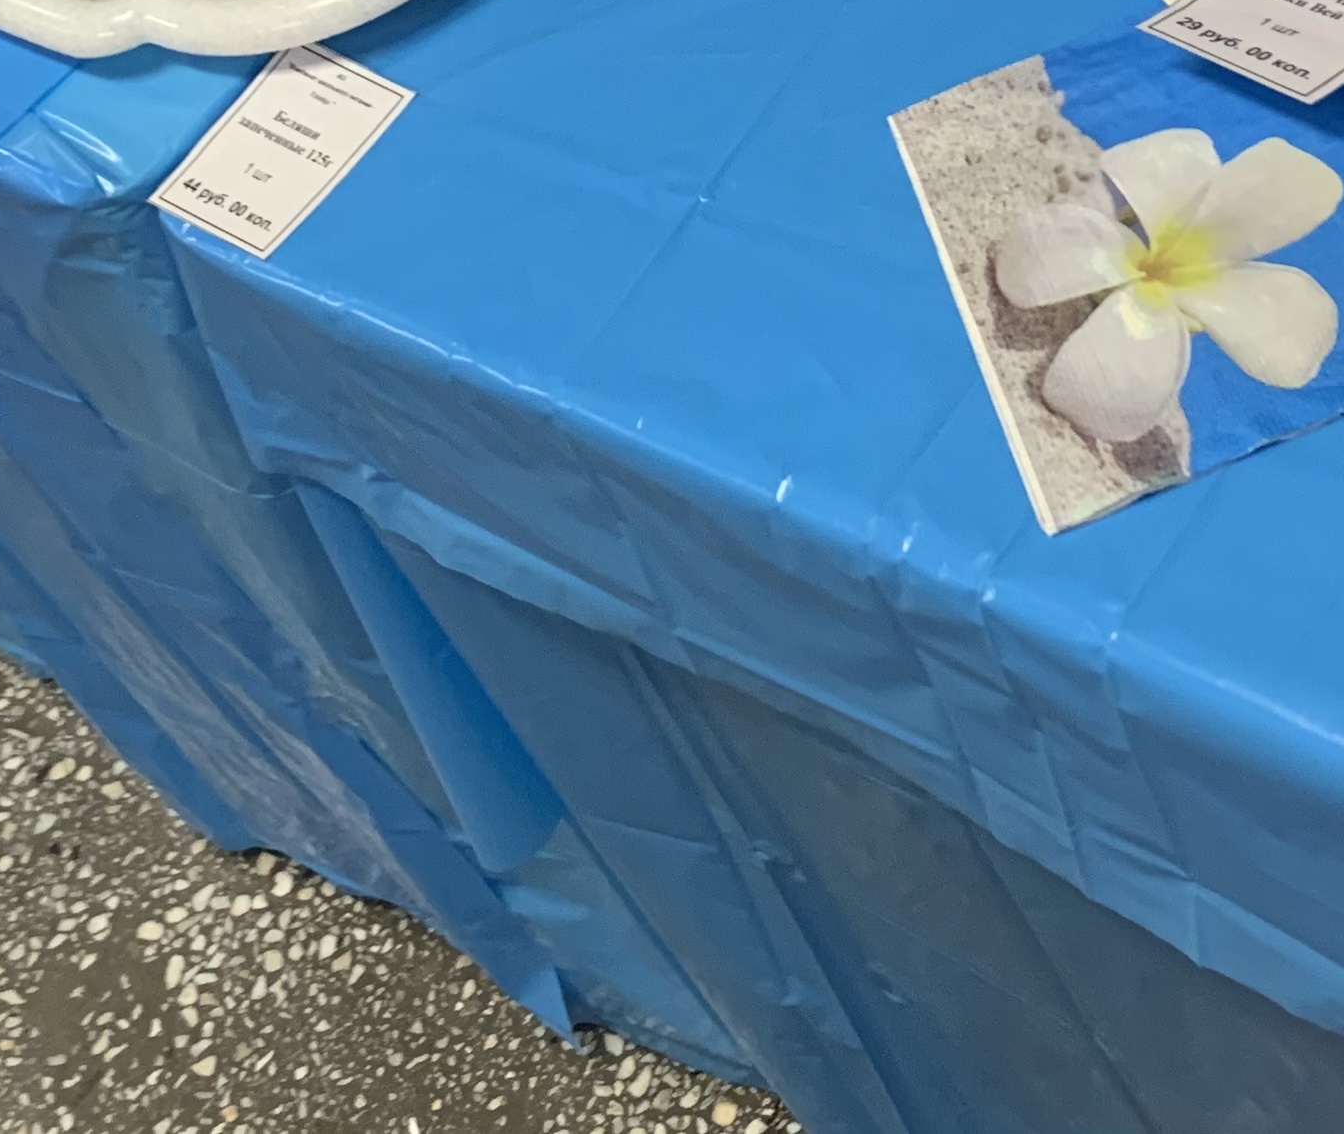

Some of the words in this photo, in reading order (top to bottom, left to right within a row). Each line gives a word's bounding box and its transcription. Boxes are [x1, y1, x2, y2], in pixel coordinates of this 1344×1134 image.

[1259, 17, 1271, 28] 1
[1270, 22, 1300, 38] шт
[1175, 16, 1203, 32] 29
[1199, 27, 1242, 50] руб.
[1245, 46, 1274, 63] 00
[1271, 57, 1311, 80] коп.
[305, 147, 336, 170] 125г
[251, 168, 274, 184] шт
[181, 177, 202, 193] 44
[198, 187, 228, 209] руб.
[228, 200, 249, 218] 00
[245, 208, 274, 233] коп.
